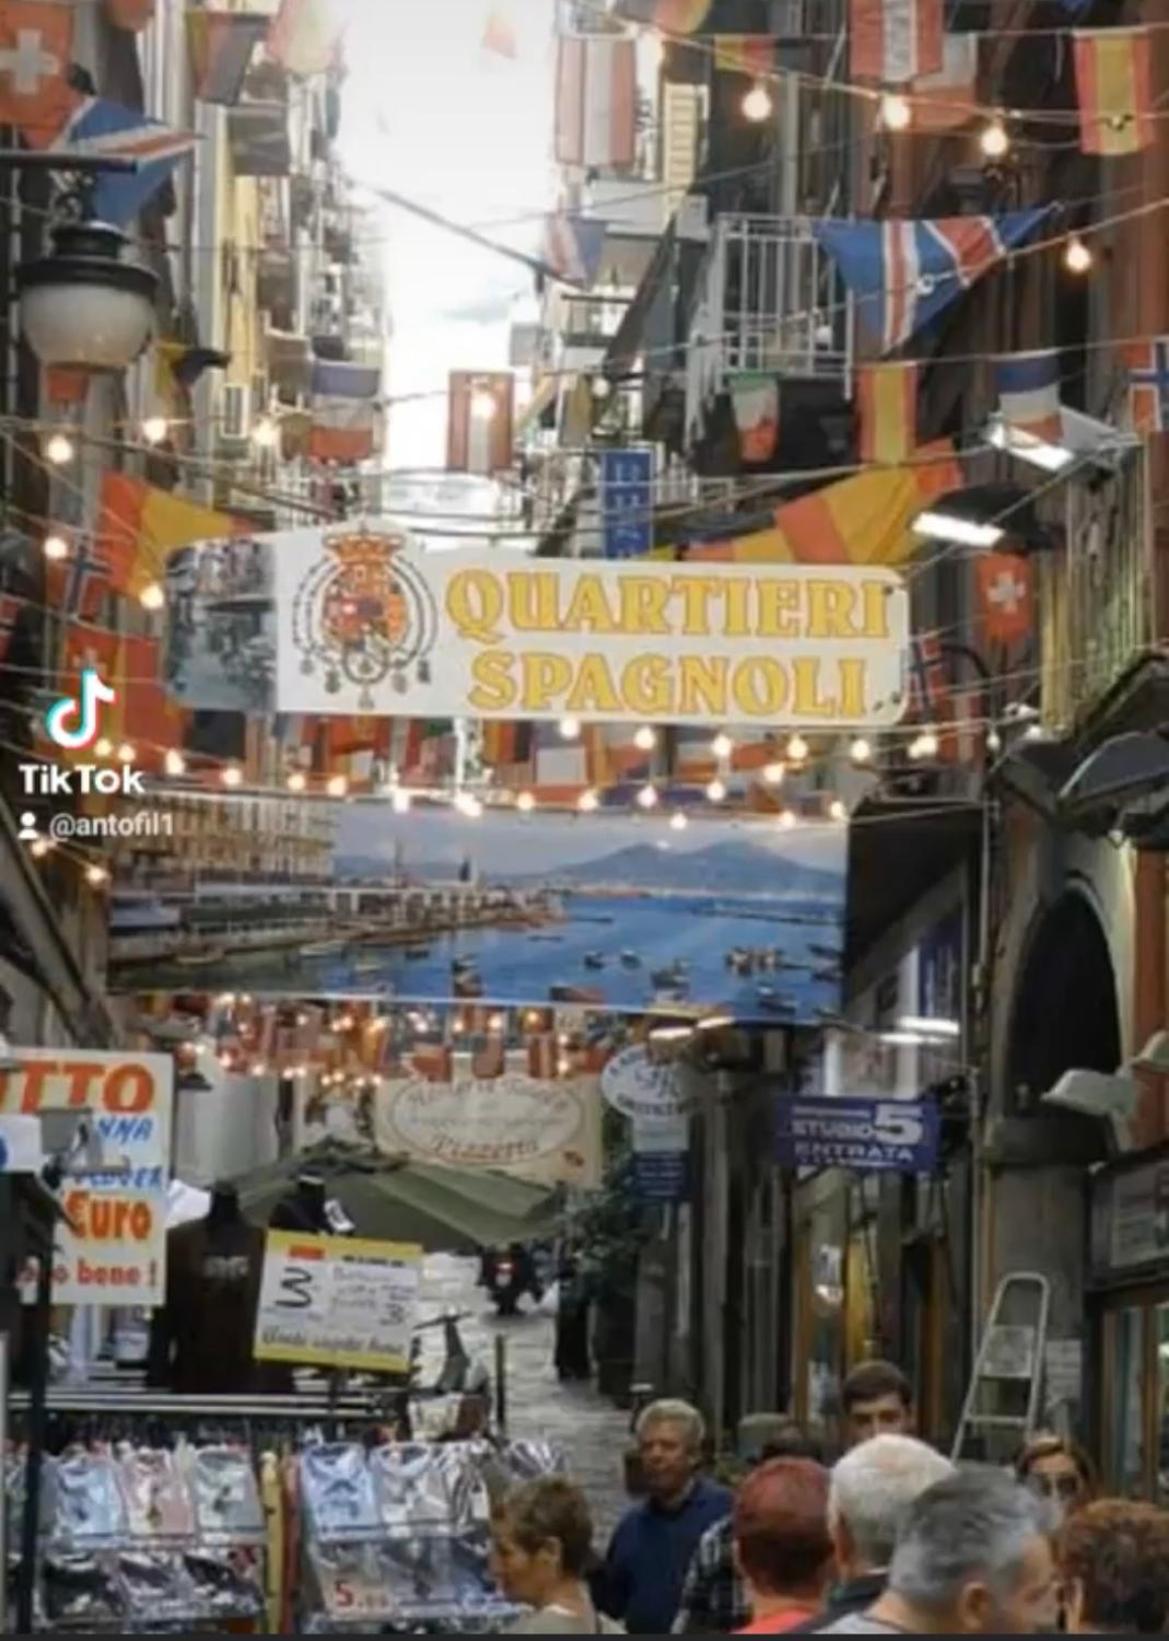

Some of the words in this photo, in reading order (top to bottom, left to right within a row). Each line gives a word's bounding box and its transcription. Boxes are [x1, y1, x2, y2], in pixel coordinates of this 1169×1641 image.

[445, 568, 889, 644] QUARTIERI
[467, 650, 867, 719] SPAGNOLI
[0, 1060, 155, 1114] TTO
[873, 1103, 923, 1146] 5
[794, 1141, 914, 1164] ENTRATA
